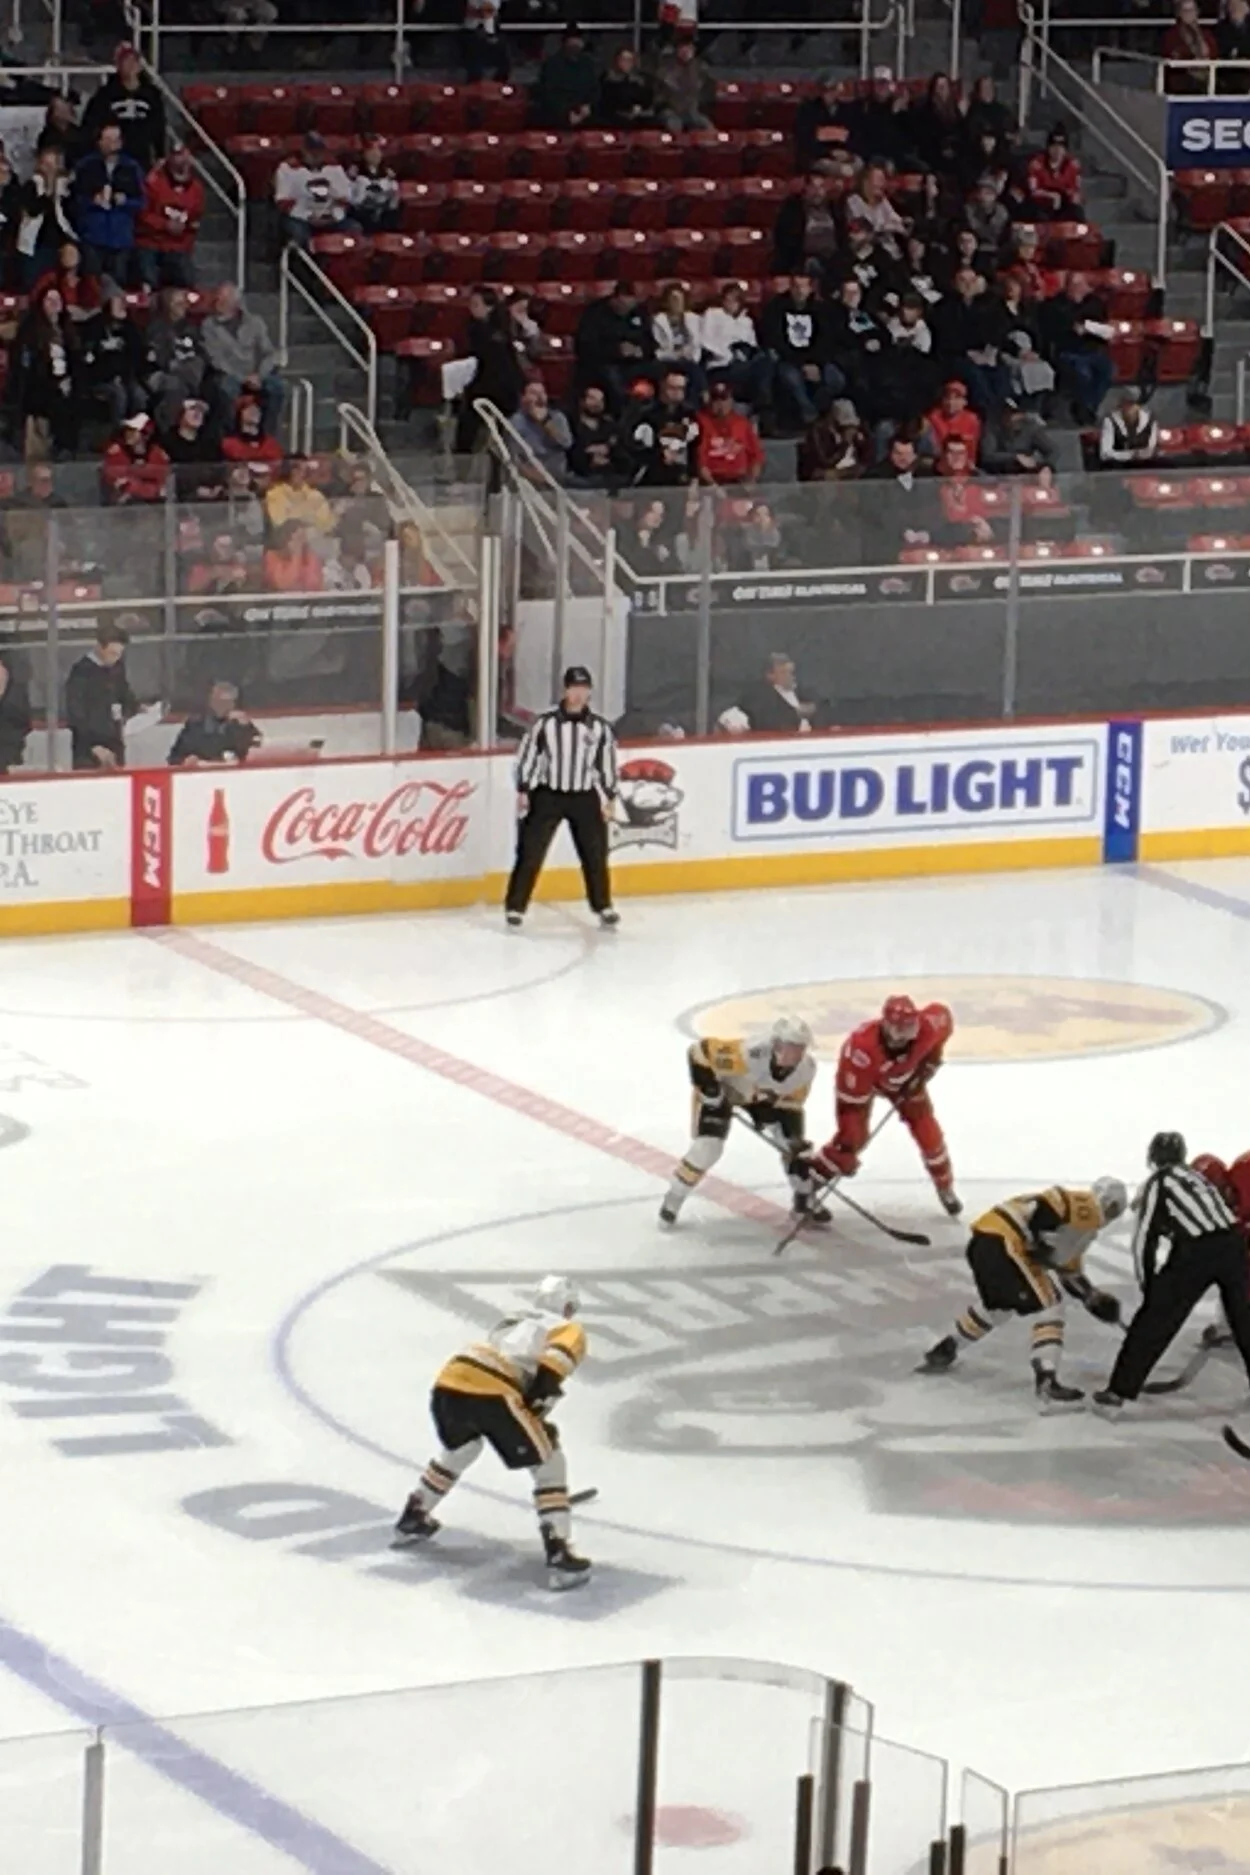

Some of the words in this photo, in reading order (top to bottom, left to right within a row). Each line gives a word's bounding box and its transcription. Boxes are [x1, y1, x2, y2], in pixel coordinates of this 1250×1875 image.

[746, 768, 884, 825] BUD
[895, 755, 1084, 818] LIGHT
[1114, 732, 1133, 830] CCM
[143, 784, 162, 889] CCM
